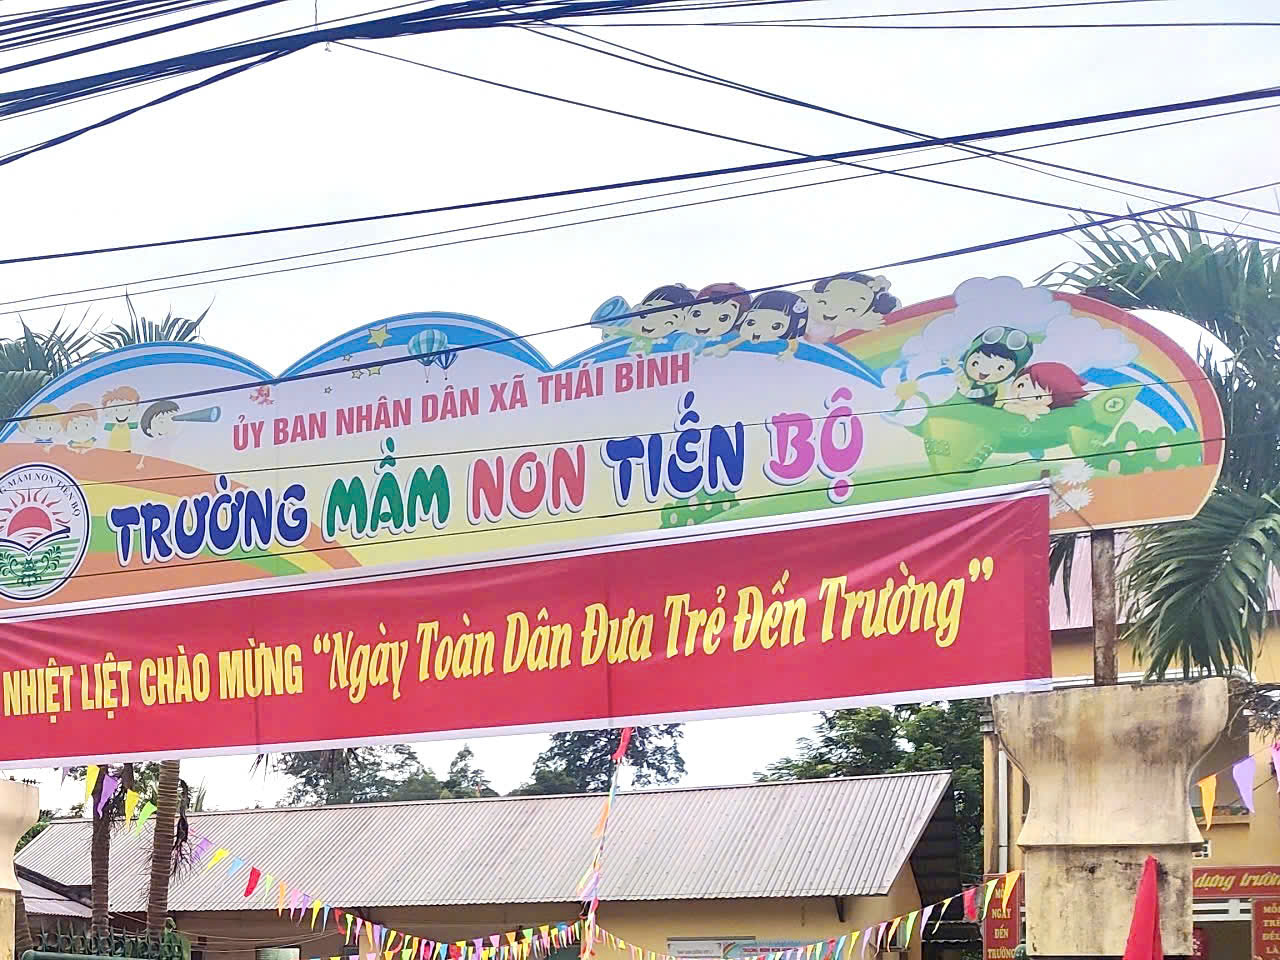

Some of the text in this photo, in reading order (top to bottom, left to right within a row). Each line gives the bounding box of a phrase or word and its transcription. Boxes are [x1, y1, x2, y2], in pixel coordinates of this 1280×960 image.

[110, 386, 865, 562] TRƯỜNG MẦM NON TIẾN BỘ
[233, 352, 691, 451] ỦY BAN NHÂN DÂN XÃ THÁI BÌNH
[2, 656, 73, 724] NHIỆT
[80, 651, 133, 720] LIỆT
[139, 644, 211, 707] CHÀO
[218, 637, 304, 700] MỪNG
[416, 612, 496, 683] Toàn
[503, 606, 573, 675] Dân
[581, 601, 655, 667] Đưa
[663, 584, 727, 659] Trẻ
[732, 568, 807, 653] Đến
